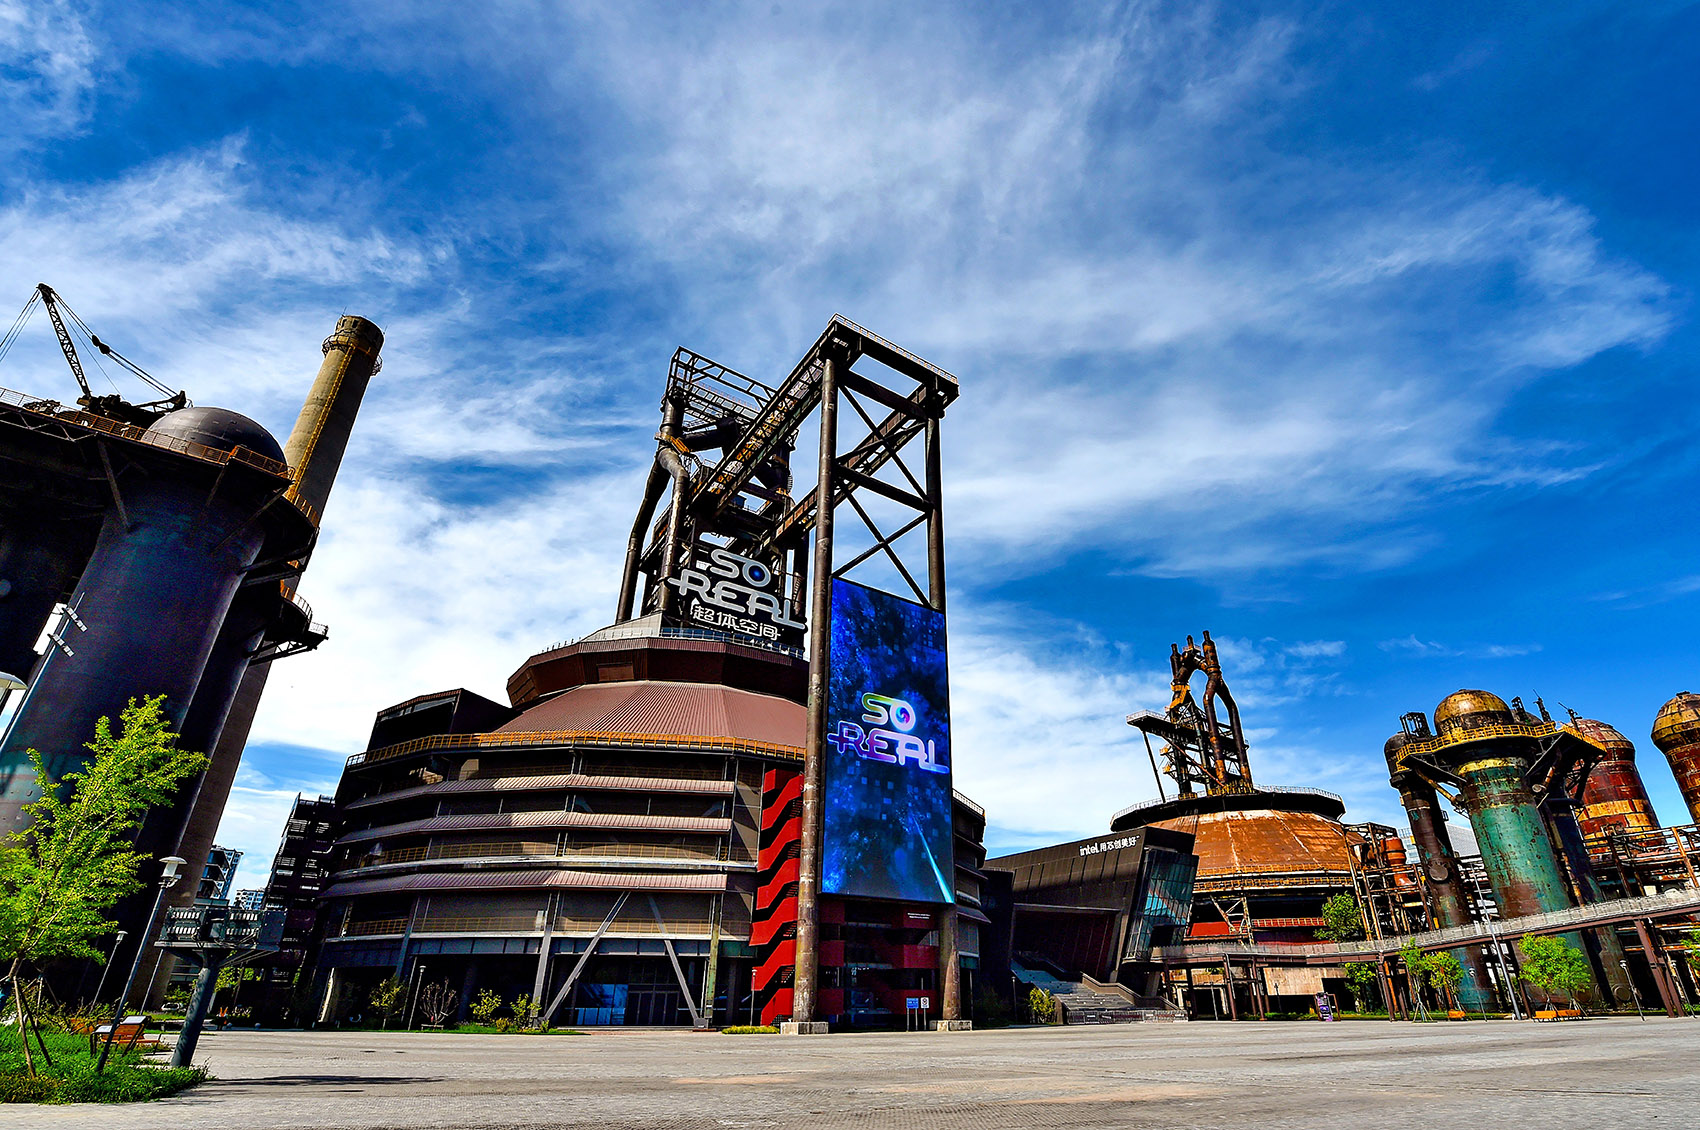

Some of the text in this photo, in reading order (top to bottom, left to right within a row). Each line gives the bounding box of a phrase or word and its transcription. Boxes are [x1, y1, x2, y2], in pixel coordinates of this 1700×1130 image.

[710, 549, 771, 587] SO
[668, 568, 806, 630] REAL
[691, 603, 781, 641] 超体空间
[861, 692, 916, 732] SO
[827, 720, 950, 774] REAL
